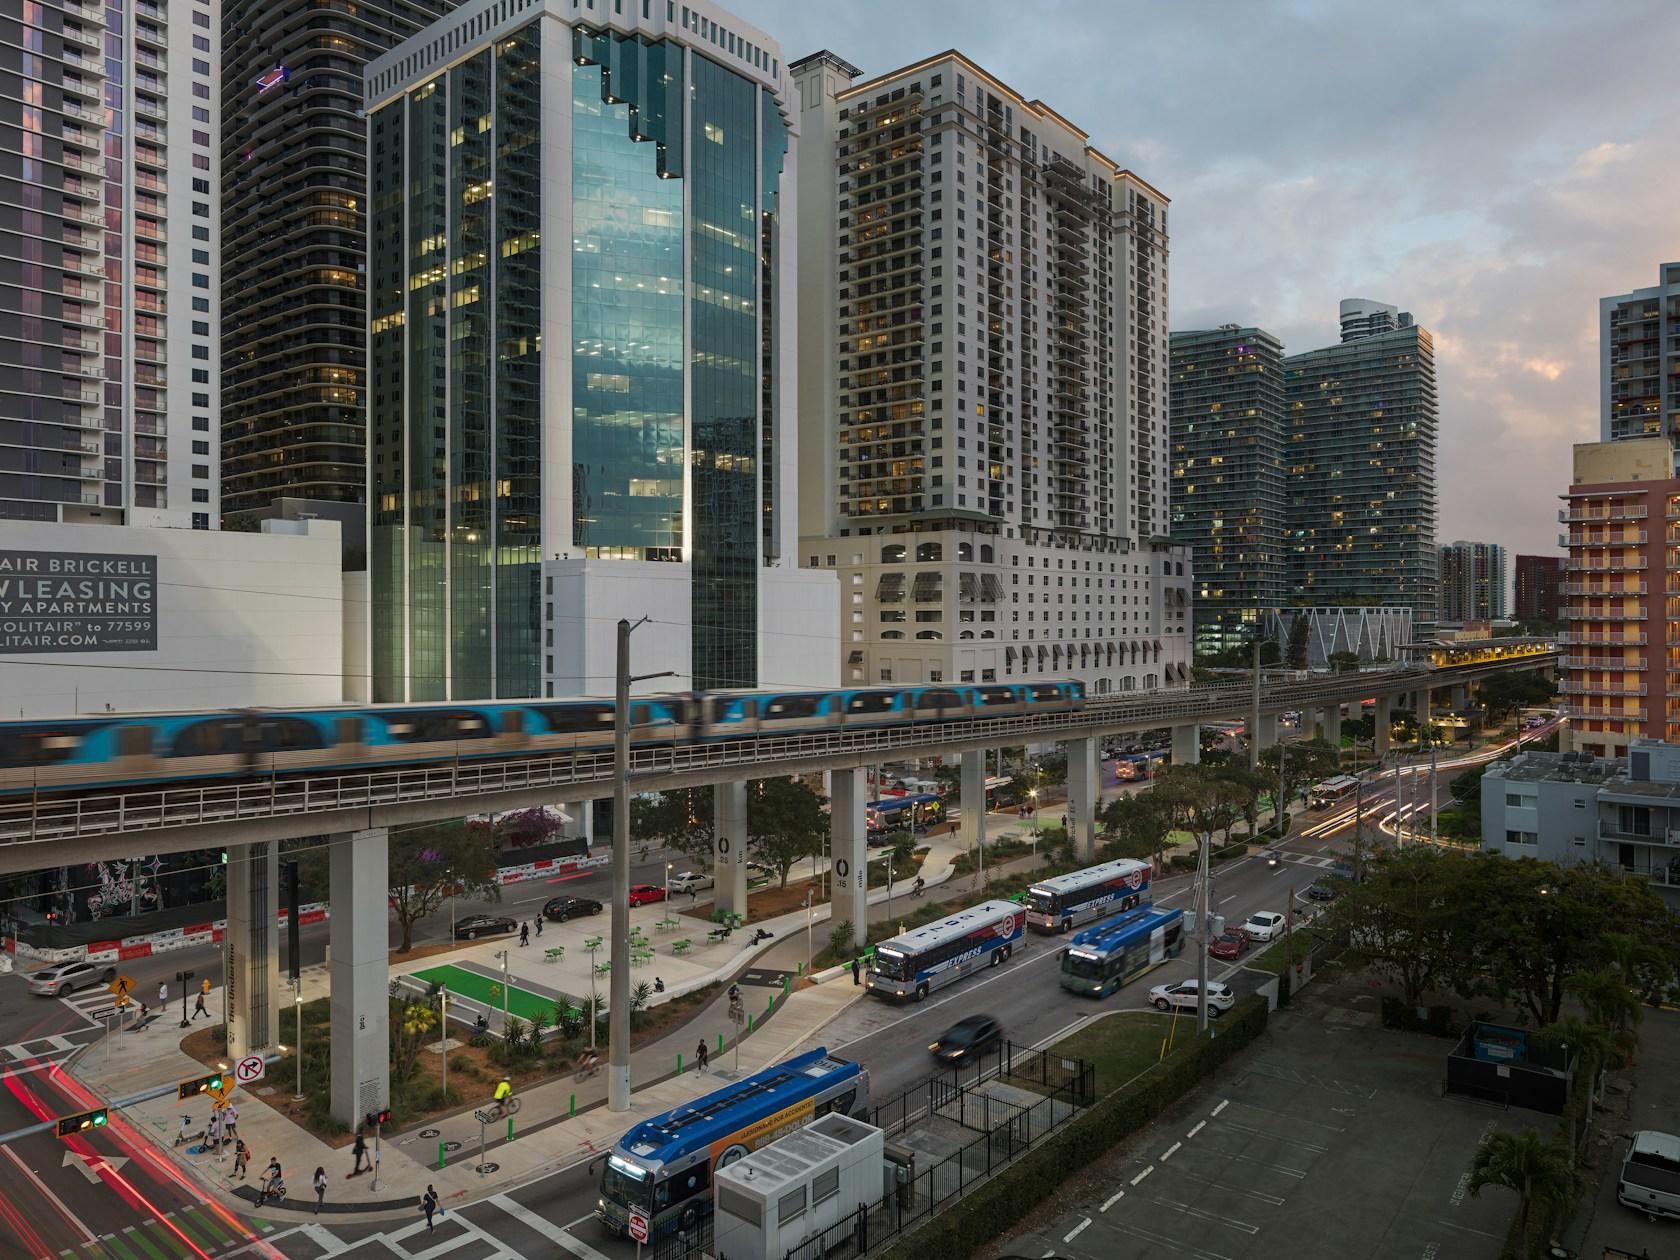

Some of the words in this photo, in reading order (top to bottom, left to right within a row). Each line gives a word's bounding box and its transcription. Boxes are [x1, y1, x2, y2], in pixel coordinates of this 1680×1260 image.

[49, 559, 151, 574] BRICKELL
[18, 580, 151, 599] LEASING
[21, 602, 151, 614] APARTMENTS
[0, 621, 81, 632] OLITAIR"
[87, 623, 102, 632] to
[107, 621, 151, 632] 77599
[1087, 893, 1115, 909] EXPRESS
[947, 946, 982, 969] EXPRESS
